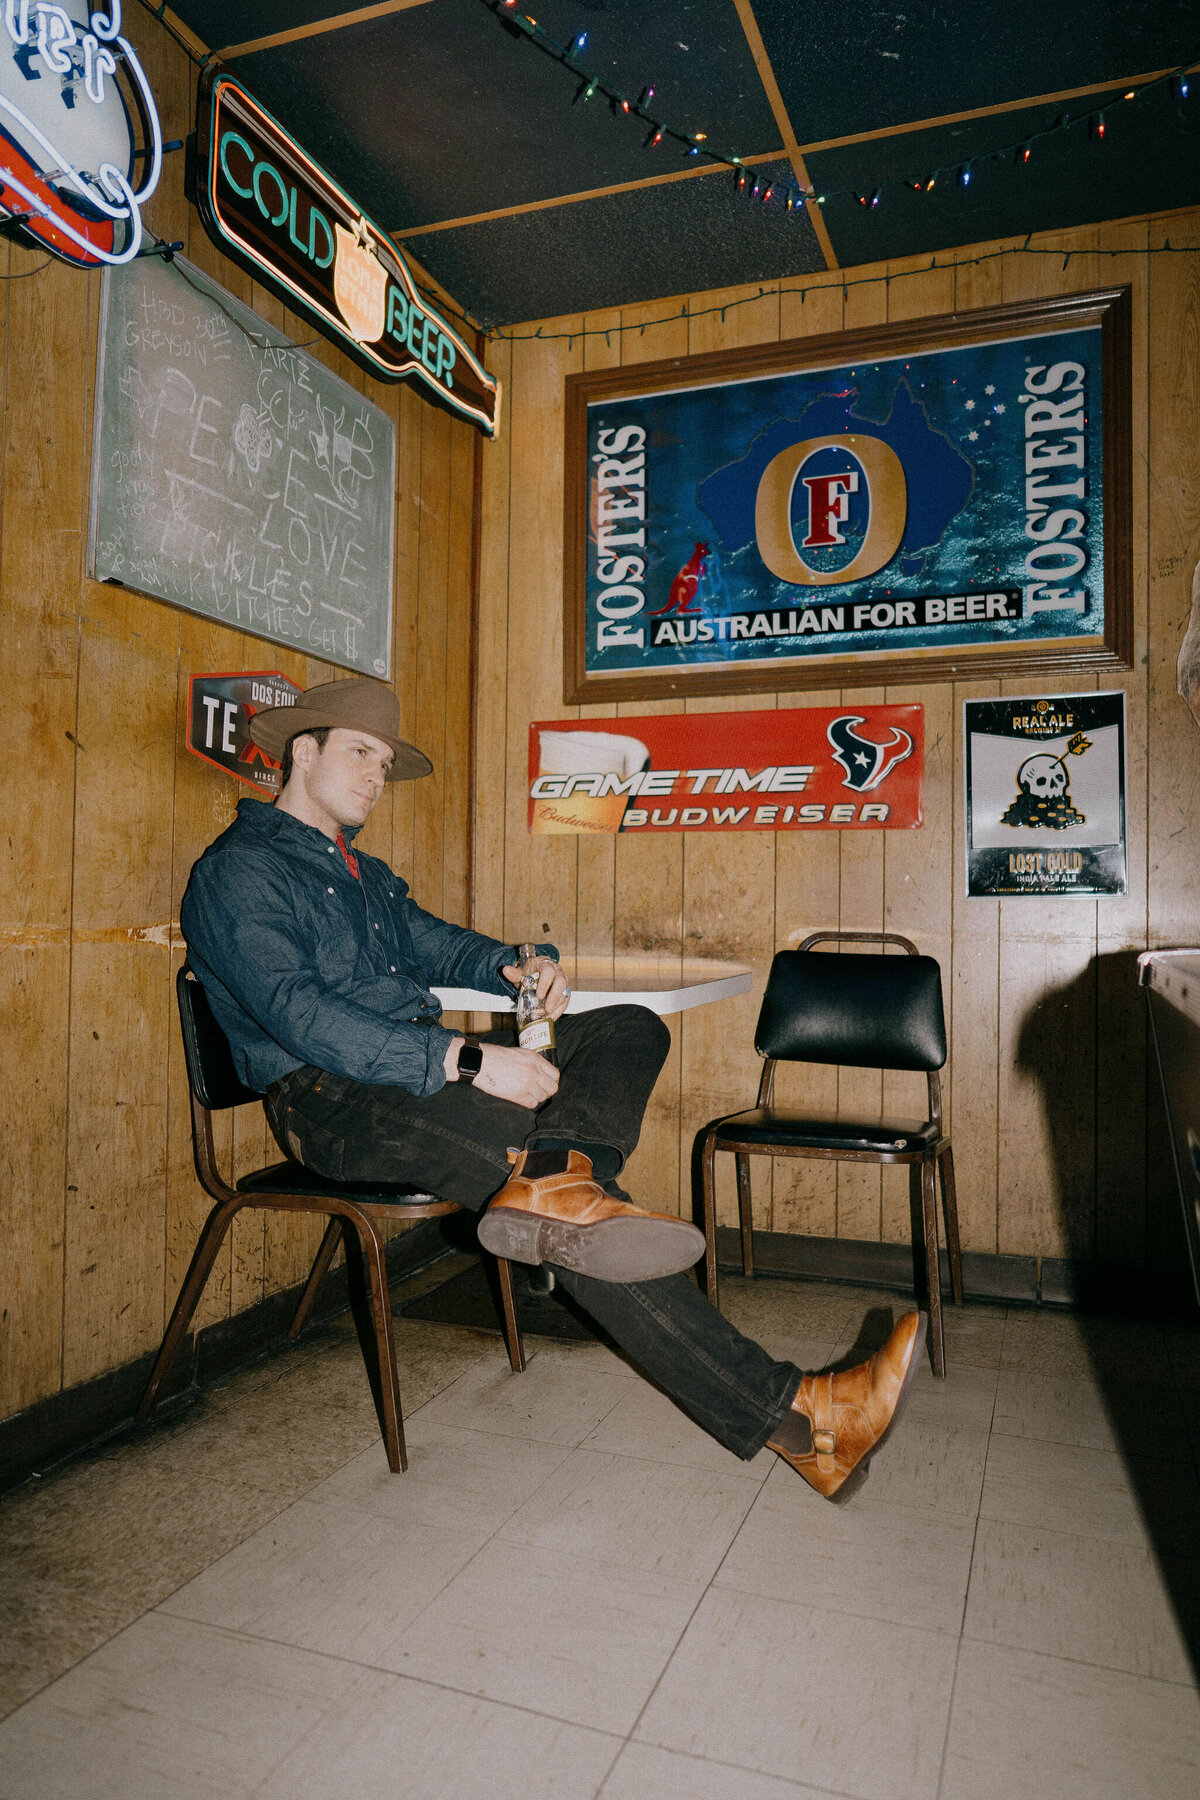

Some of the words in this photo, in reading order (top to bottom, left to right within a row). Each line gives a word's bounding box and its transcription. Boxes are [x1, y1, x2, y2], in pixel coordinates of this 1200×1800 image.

[219, 131, 335, 269] COLD
[386, 284, 456, 389] BEER
[141, 286, 186, 326] HBD
[125, 321, 208, 368] GREYSON
[801, 471, 860, 549] F
[1021, 361, 1086, 618] FOSTER'S
[259, 503, 368, 588] LOVE
[593, 424, 648, 651] FOSTER'S
[212, 566, 302, 638] BITCHES
[308, 618, 337, 655] GET
[654, 606, 845, 645] AUSTRALIAN
[852, 599, 916, 628] FOR
[923, 594, 1017, 624] BEER.
[252, 682, 272, 705] DOS
[1013, 715, 1047, 730] REAL
[1049, 713, 1074, 727] ALE
[530, 770, 681, 799] GAME
[687, 766, 814, 795] TIME
[538, 805, 616, 831] Budweiser
[622, 803, 890, 828] BUDWEISER
[1009, 853, 1042, 874] LOST
[1047, 852, 1082, 874] GOLD
[1061, 874, 1077, 883] ALE
